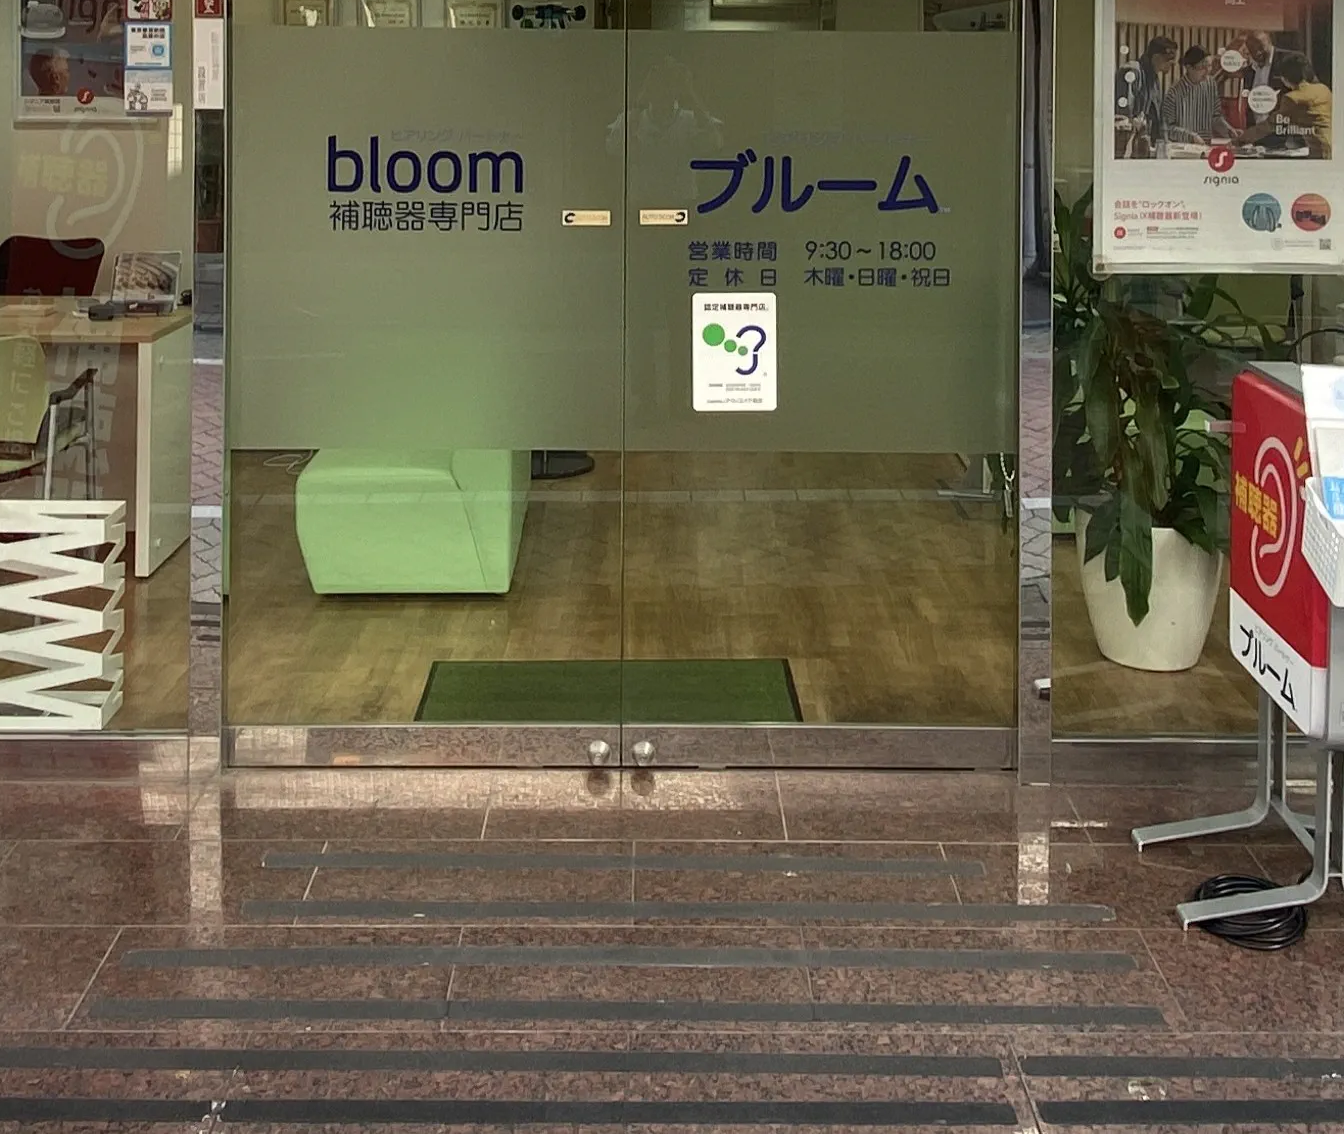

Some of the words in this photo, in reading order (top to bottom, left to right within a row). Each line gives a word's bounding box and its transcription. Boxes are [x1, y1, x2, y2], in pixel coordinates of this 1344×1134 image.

[326, 135, 525, 194] bloom
[690, 148, 939, 213] ブルーム
[1203, 175, 1239, 187] signia
[329, 200, 524, 232] 補聴器専門店
[688, 241, 777, 261] 営業時間
[1235, 470, 1279, 539] 補聴器
[1239, 624, 1296, 710] ブルーム
